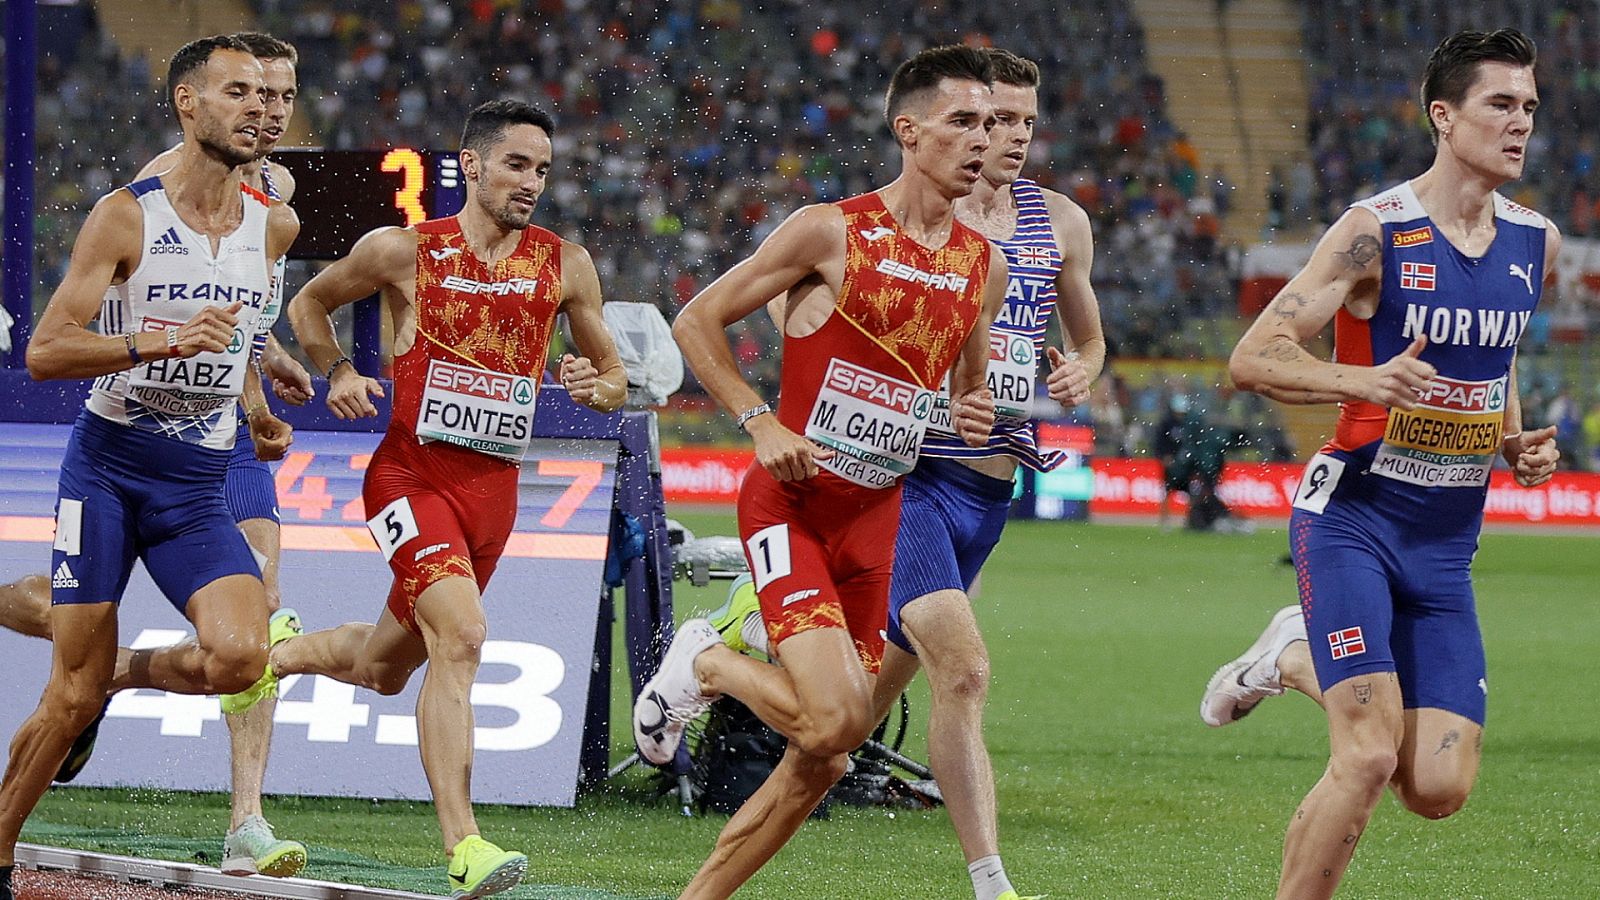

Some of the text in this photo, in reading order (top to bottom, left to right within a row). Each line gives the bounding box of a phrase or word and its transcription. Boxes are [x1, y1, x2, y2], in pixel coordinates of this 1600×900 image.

[380, 148, 427, 226] 3
[150, 245, 189, 255] adidas
[1403, 232, 1430, 243] EXTRA
[440, 275, 538, 296] ESPAÑA
[875, 258, 969, 293] ESPAÑA
[1005, 278, 1046, 302] AT
[146, 283, 263, 309] FRANCE
[995, 303, 1040, 328] AIN
[1401, 303, 1532, 347] NORWAY
[146, 358, 234, 389] HABZ
[431, 366, 511, 400] SPAR
[829, 367, 914, 411] SPAR
[987, 371, 1030, 402] ARD
[129, 385, 225, 413] MUNICH 2022
[423, 398, 528, 440] FONTES
[813, 400, 919, 459] M. GARCÍA
[1388, 411, 1501, 451] INGEBRIGTSEN
[448, 436, 470, 447] RUN
[838, 442, 862, 458] RUN
[1414, 451, 1439, 463] RUN
[826, 450, 895, 487] NICH 202
[1304, 464, 1329, 500] 9
[1381, 457, 1484, 482] MUNICH 2022
[537, 460, 604, 528] 7
[384, 509, 403, 546] 5
[414, 542, 451, 562] ESP
[759, 536, 772, 574] 1
[52, 578, 80, 588] adidas
[782, 588, 820, 608] ESP
